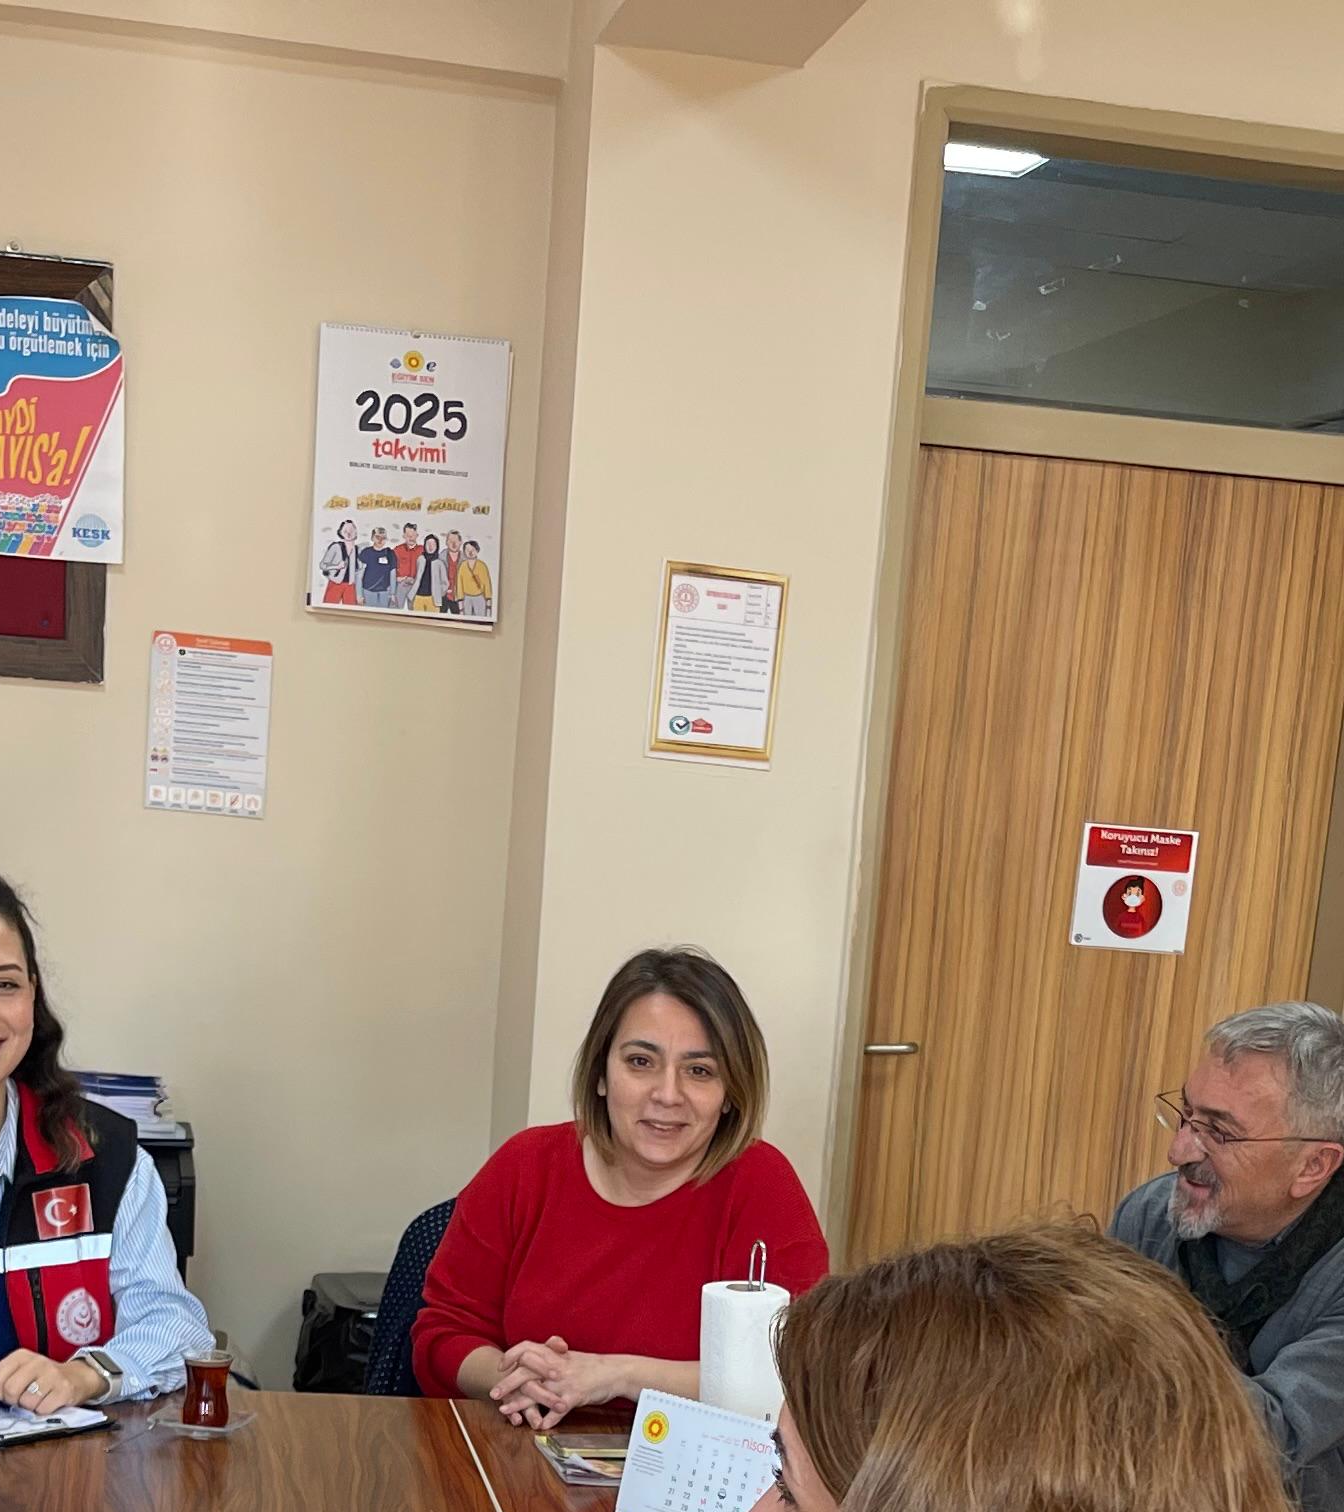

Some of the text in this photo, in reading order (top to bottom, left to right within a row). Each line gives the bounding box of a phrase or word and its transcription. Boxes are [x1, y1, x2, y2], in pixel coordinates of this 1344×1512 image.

[9, 331, 83, 357] örgütlemek
[86, 338, 110, 362] için
[356, 389, 468, 441] 2025
[372, 438, 447, 464] takvimi
[72, 527, 111, 541] KESK
[1100, 830, 1182, 846] Koruyucu Maske
[741, 1438, 772, 1456] nisan
